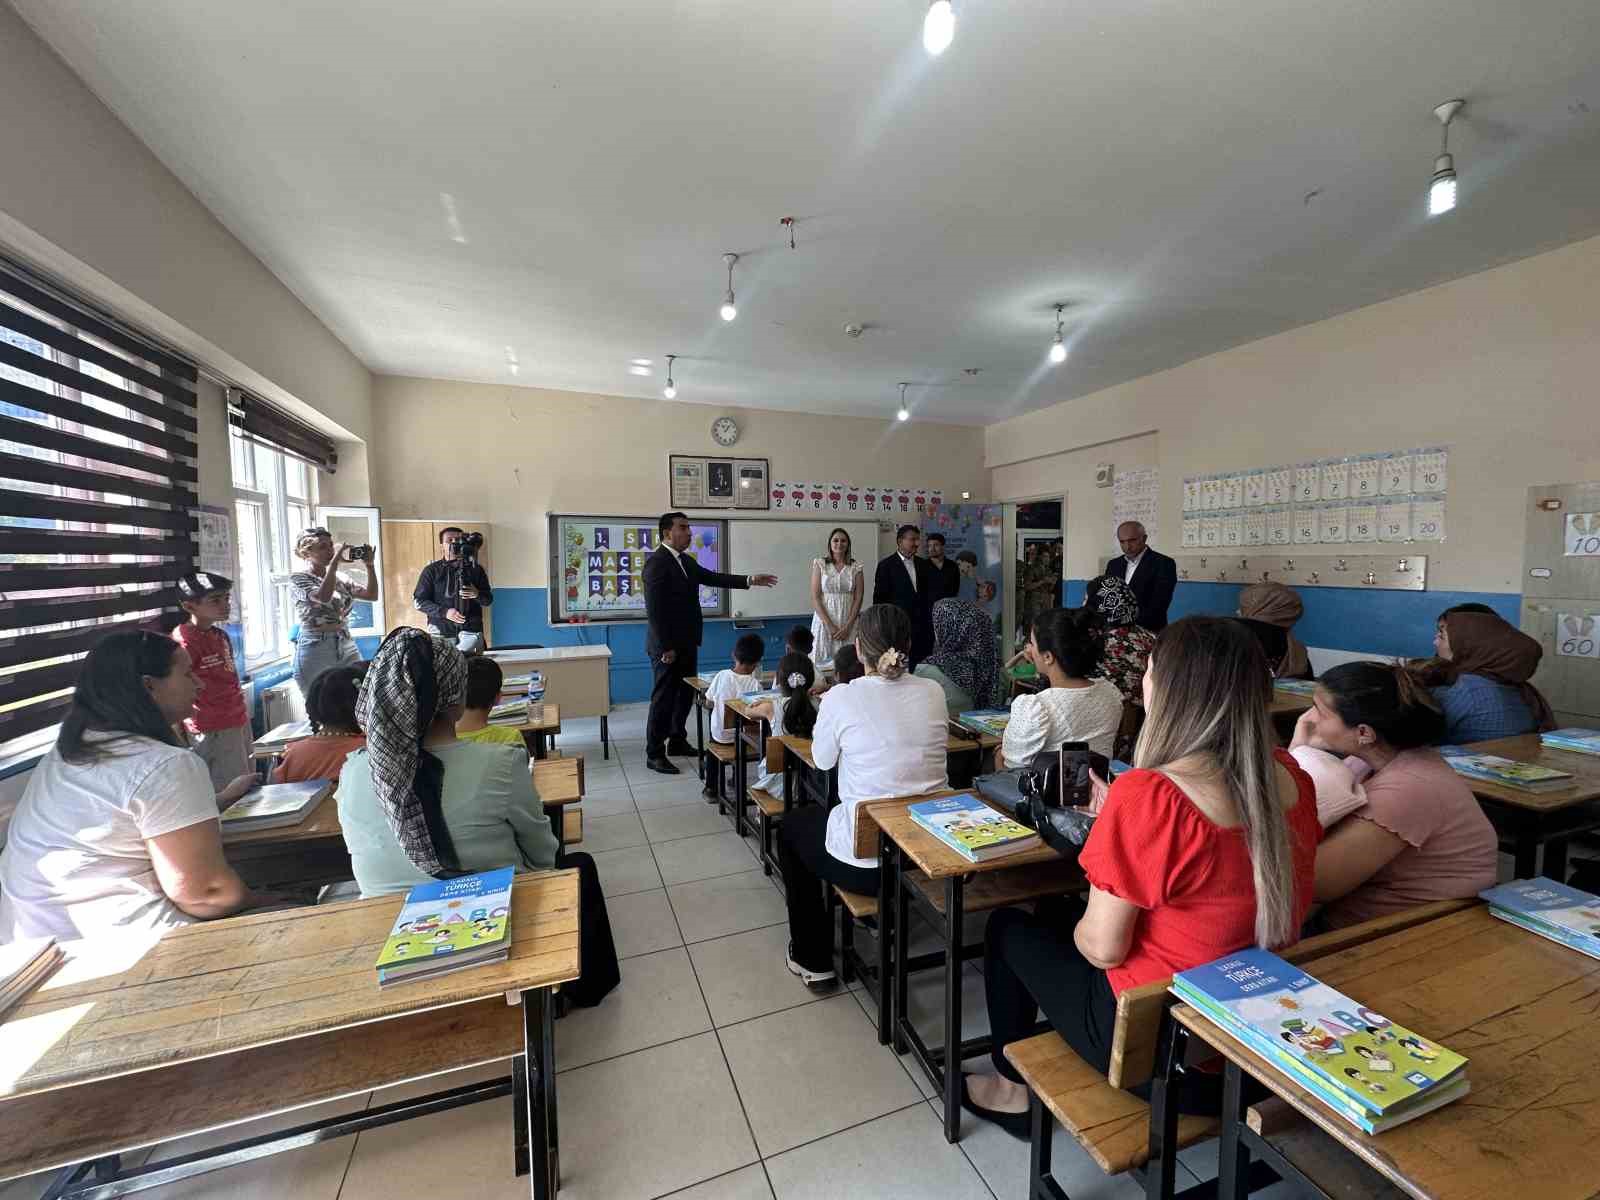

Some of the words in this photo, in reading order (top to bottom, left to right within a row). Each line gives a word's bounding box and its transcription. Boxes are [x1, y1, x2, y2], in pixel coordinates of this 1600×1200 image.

[1303, 486, 1311, 496] 6
[1359, 480, 1368, 490] 8
[1391, 476, 1400, 488] 9
[1423, 472, 1438, 484] 10
[794, 500, 801, 508] 4
[814, 500, 820, 508] 6
[832, 501, 838, 509] 8
[849, 502, 857, 511] 10
[866, 502, 874, 511] 12
[882, 503, 891, 512] 14
[1301, 528, 1311, 537] 16
[1329, 527, 1339, 537] 17
[1358, 525, 1368, 535] 18
[1420, 523, 1436, 533] 20
[1562, 638, 1594, 655] 60
